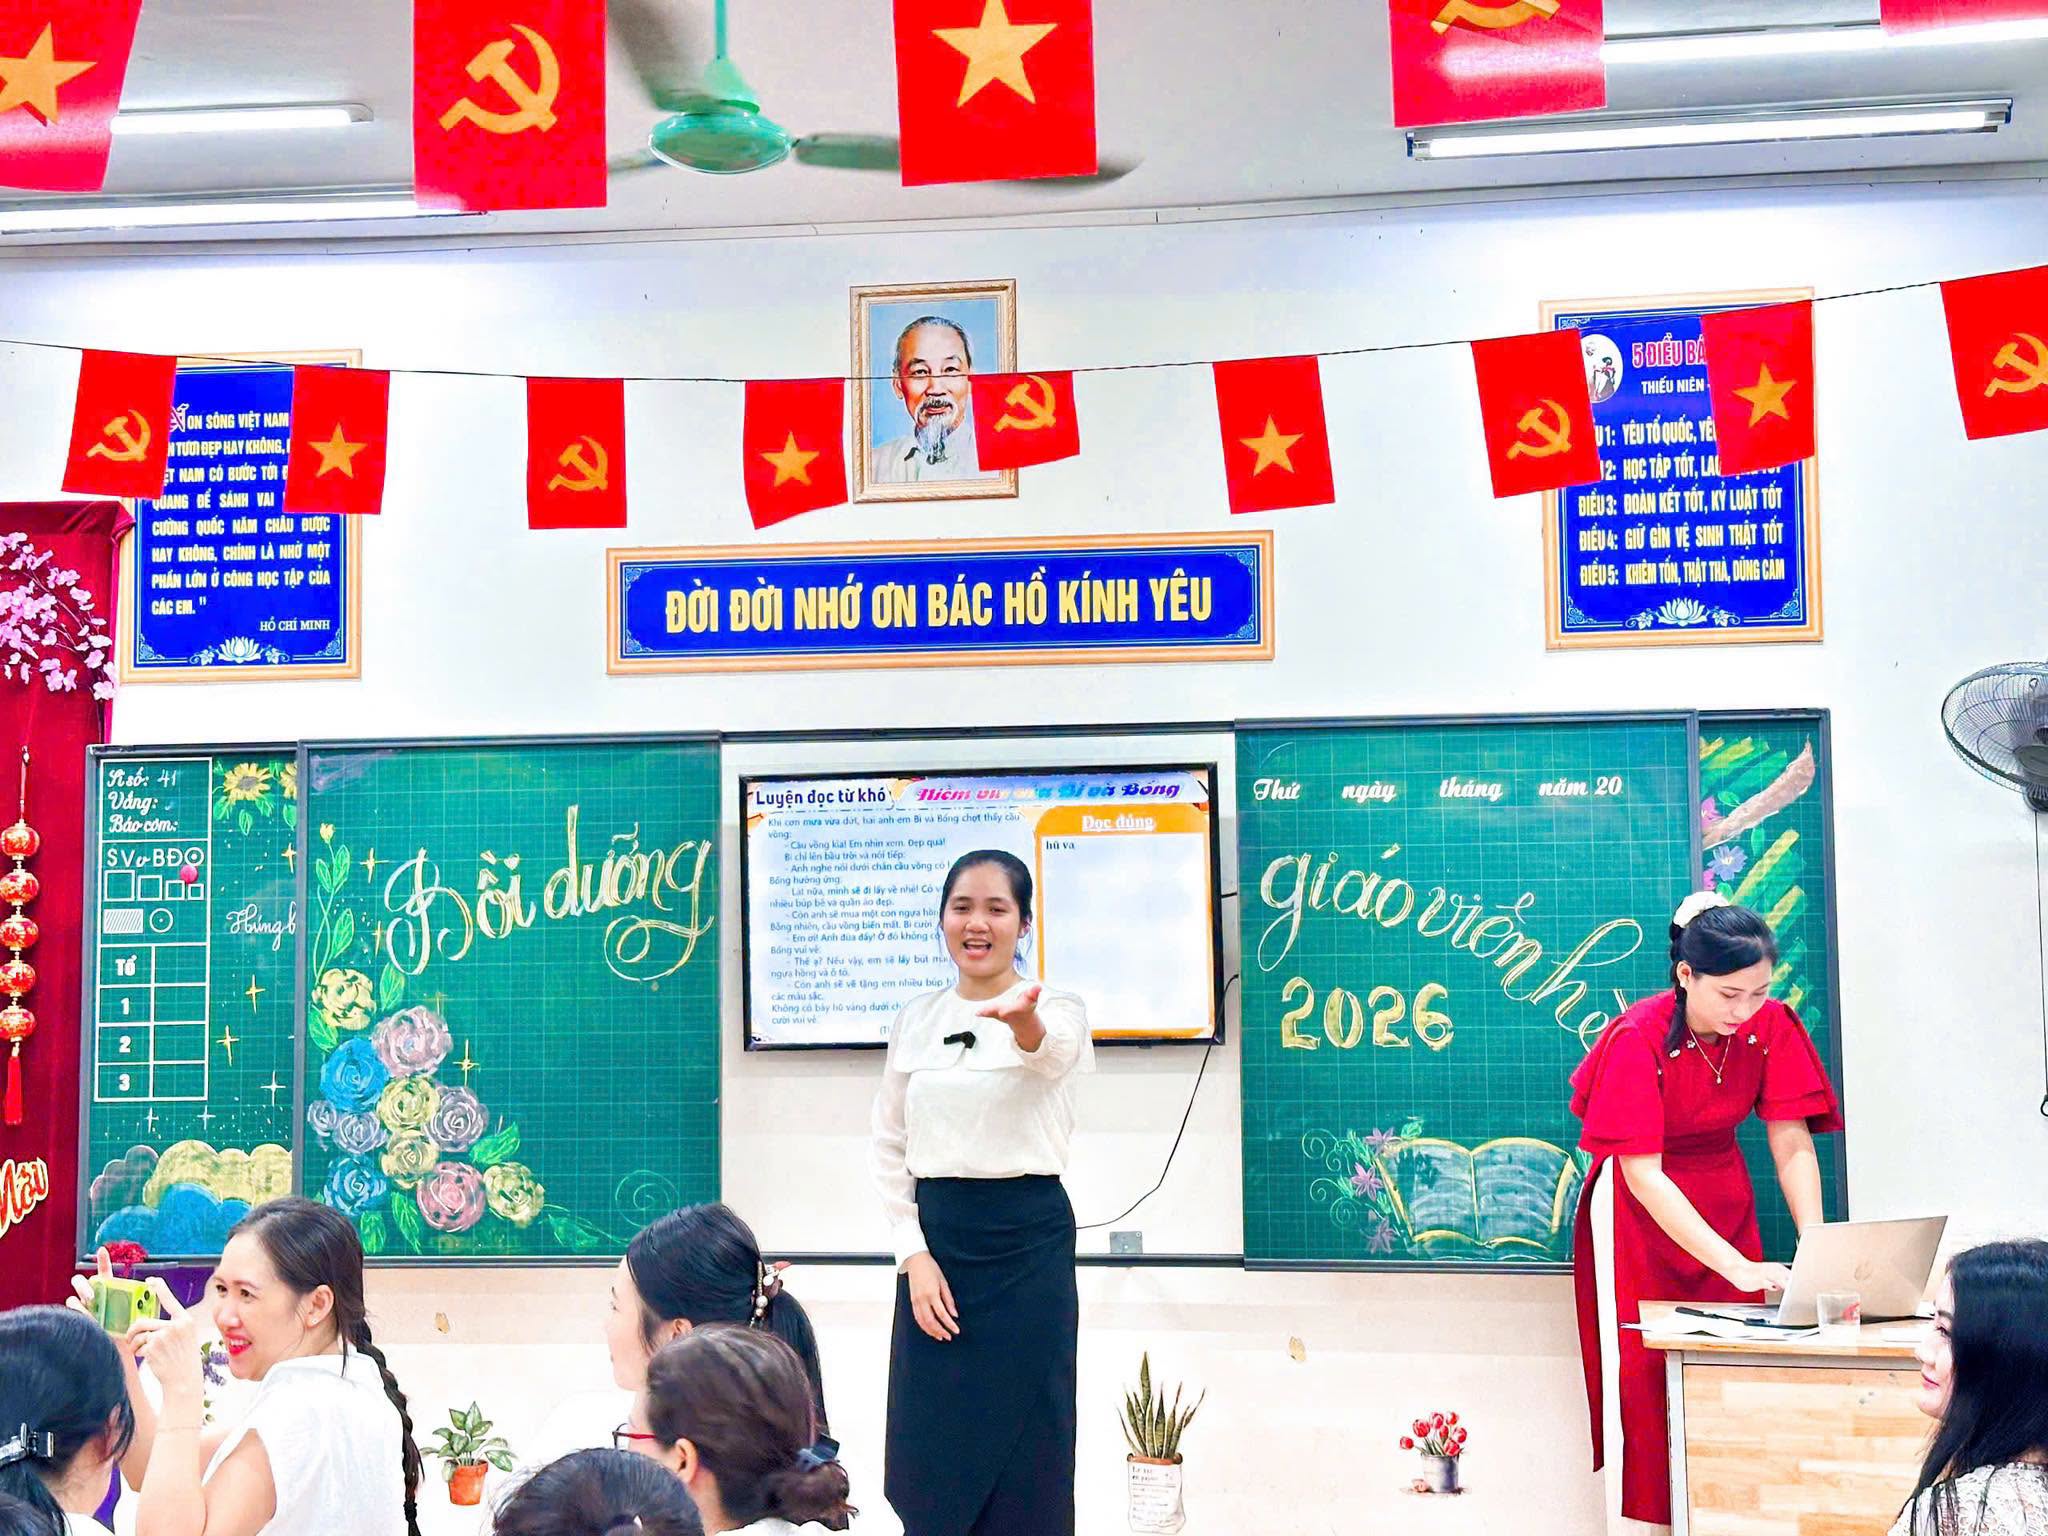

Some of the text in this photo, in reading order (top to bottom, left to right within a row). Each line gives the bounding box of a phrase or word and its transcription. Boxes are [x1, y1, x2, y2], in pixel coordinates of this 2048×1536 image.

[1632, 333, 1708, 368] 5 ĐIỀU BÁ
[1641, 376, 1705, 395] THIẾU NIÊN
[206, 411, 235, 430] SÔNG
[238, 410, 261, 432] VIỆT
[263, 412, 289, 428] NAM
[1622, 418, 1645, 446] YÊU
[1646, 414, 1661, 444] TỔ
[1662, 414, 1697, 445] QUỐC,
[176, 440, 200, 456] TƯƠI
[200, 440, 222, 459] ĐẸP
[223, 440, 245, 455] HAY
[179, 467, 205, 483] NAM
[209, 464, 224, 482] CÓ
[228, 462, 257, 481] BƯỚC
[261, 462, 278, 481] TỚI
[1623, 457, 1647, 484] HỌC
[1649, 452, 1671, 483] TẬP
[1674, 449, 1698, 479] TỐT,
[152, 488, 275, 511] QUANG ĐỂ SÁNH VAI
[1578, 488, 1605, 516] ĐIỀU
[1624, 488, 1656, 515] ĐOÀN
[1659, 484, 1680, 513] KẾT
[1684, 482, 1708, 514] TỐT,
[1711, 482, 1726, 511] KỶ
[1730, 485, 1758, 515] LUẬT
[1762, 480, 1783, 509] TỐT
[152, 515, 331, 536] CƯỜNG QUỐC NĂM CHÂU ĐƯỢC
[1579, 522, 1605, 551] ĐIỀU
[1625, 523, 1646, 549] GIỮ
[1649, 523, 1670, 548] GÌN
[1675, 521, 1690, 552] VỆ
[1695, 525, 1723, 547] SINH
[1728, 520, 1758, 550] THẬT
[1762, 515, 1783, 544] TỐT
[152, 547, 173, 562] HAY
[178, 543, 218, 562] KHÔNG,
[223, 542, 256, 561] CHÍNH
[261, 541, 275, 560] LÀ
[307, 540, 331, 561] MỘT
[185, 568, 207, 588] LỚN
[210, 566, 220, 588] Ở
[223, 569, 253, 588] CÔNG
[257, 571, 279, 590] HỌC
[283, 567, 305, 589] TẬP
[308, 564, 331, 585] CỦA
[1580, 557, 1607, 586] ĐIỀU
[1625, 559, 1657, 585] KHIÊM
[1659, 555, 1681, 586] TỐN,
[1683, 556, 1708, 587] THẬT
[1732, 556, 1760, 581] DŨNG
[1762, 550, 1785, 580] CẢM
[152, 597, 173, 615] CÁC
[665, 565, 1213, 634] ĐỜI ĐỜI NHỚ ƠN BÁC HỒ KÍNH YÊU
[260, 615, 330, 631] HỒ CHÍ MINH
[157, 769, 177, 788] 41
[1253, 776, 1623, 803] Thứ ngày tháng năm 20
[756, 787, 886, 809] Luyện đọc từ khó
[384, 804, 715, 981] Bồi dưỡng
[1258, 843, 1415, 972] giáo
[120, 997, 130, 1015] 1
[1281, 976, 1455, 1052] 2026
[119, 1035, 131, 1053] 2
[119, 1073, 130, 1092] 3
